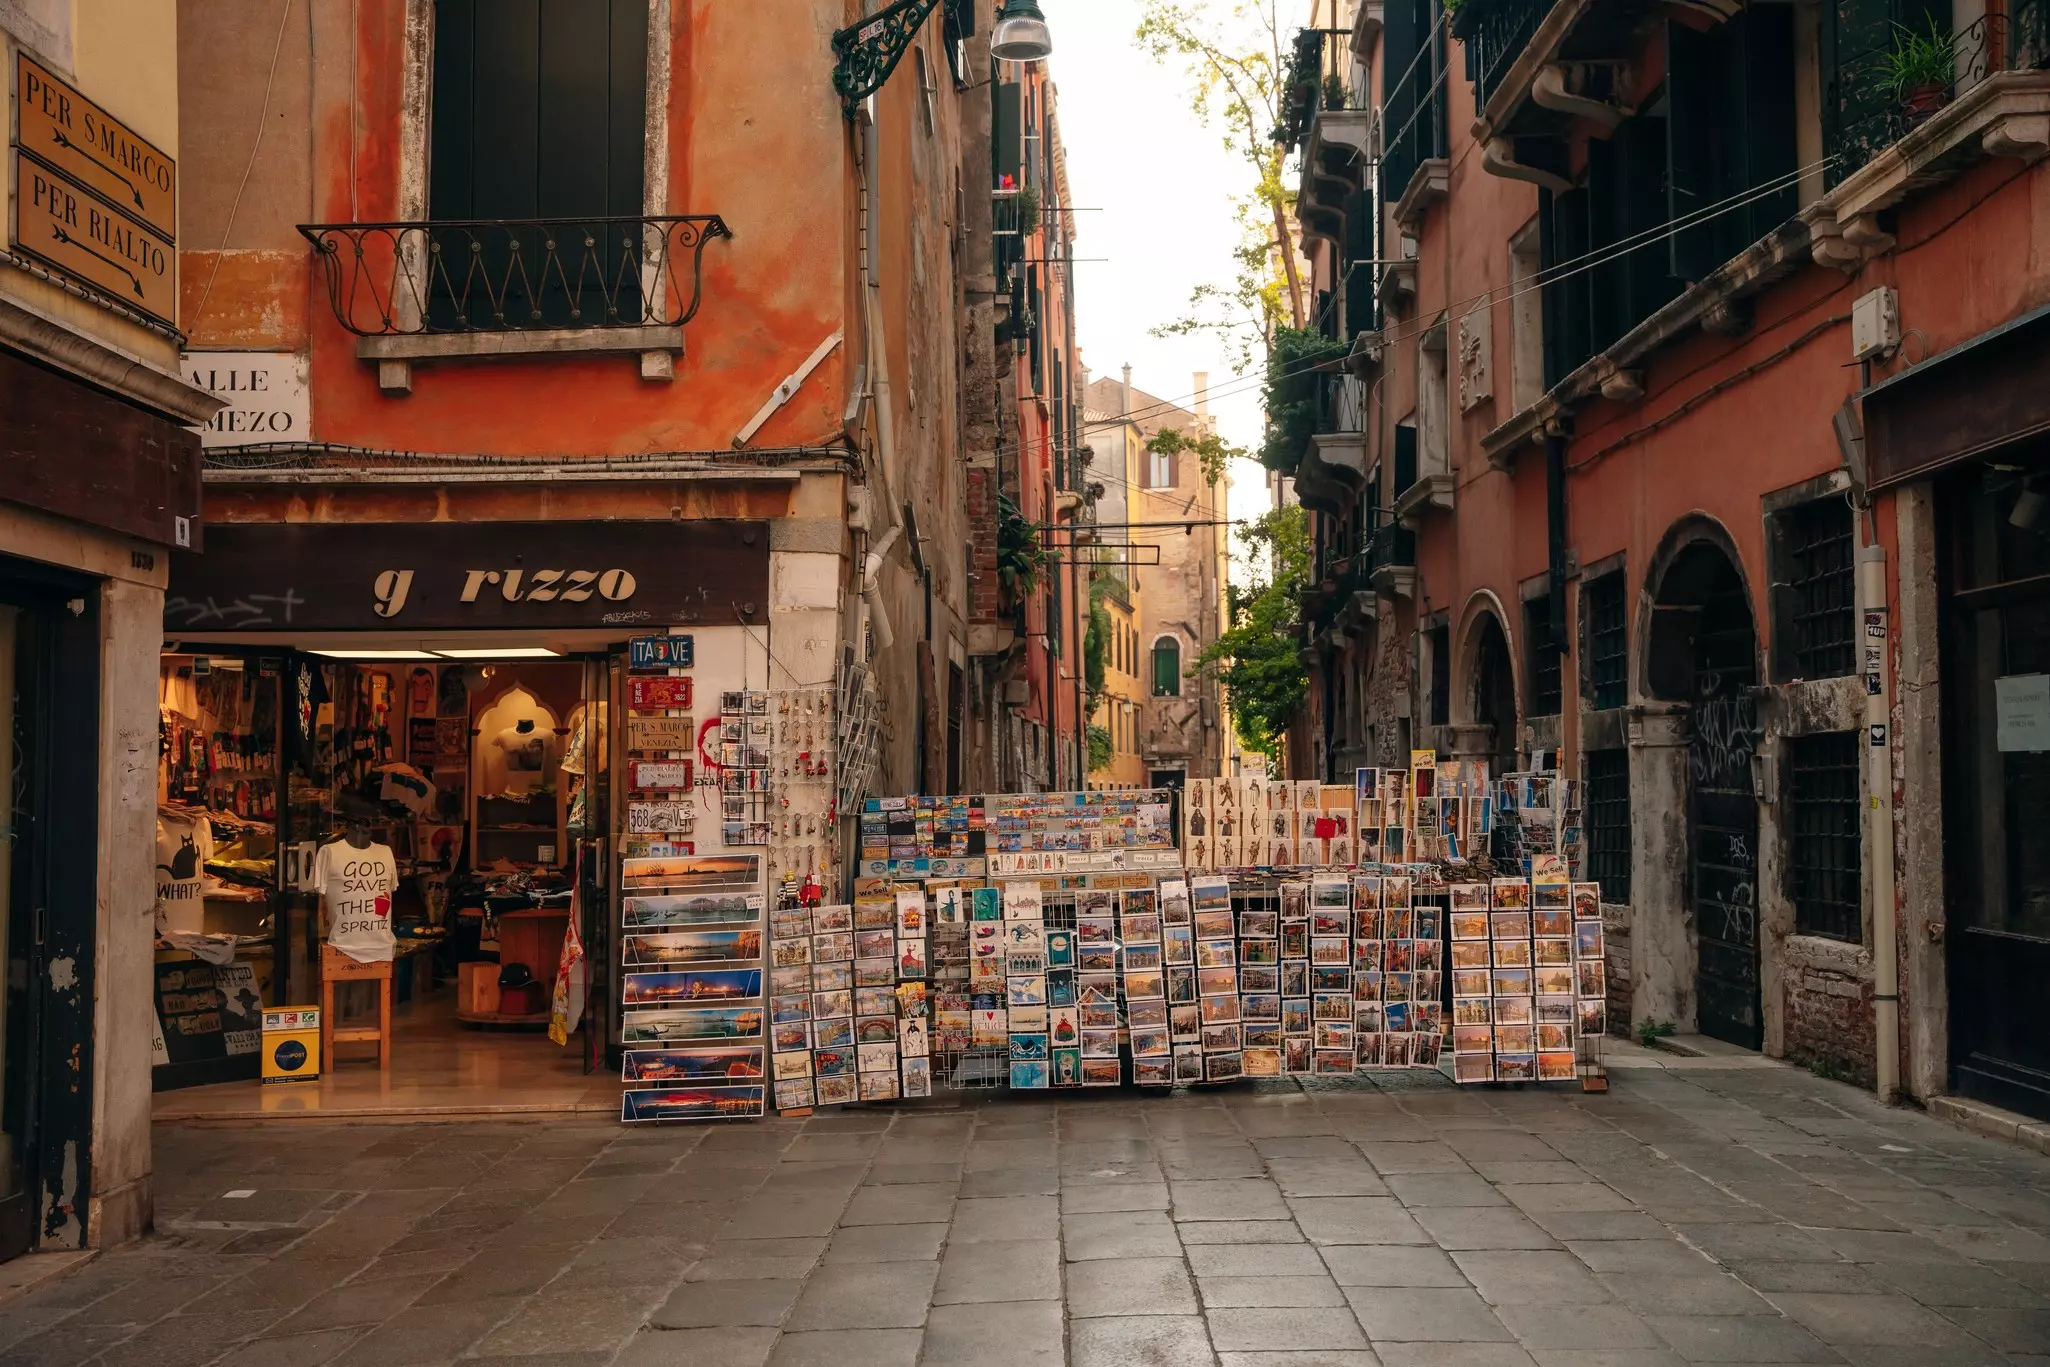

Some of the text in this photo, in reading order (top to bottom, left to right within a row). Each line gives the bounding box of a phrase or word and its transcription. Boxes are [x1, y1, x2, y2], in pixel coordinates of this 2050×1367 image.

[25, 71, 171, 193] PER S.MARCO
[33, 174, 166, 277] PER RIALTO
[181, 370, 269, 391] ALLE
[202, 411, 293, 432] MEZO
[373, 568, 637, 618] g rizzo
[633, 641, 689, 662] ITA VE
[632, 722, 646, 732] PER
[660, 722, 690, 732] MARCO
[630, 808, 649, 827] 568
[343, 861, 386, 879] GOD
[1535, 865, 1564, 877] We Sell
[156, 882, 202, 900] WHAT?
[342, 878, 388, 893] SAVE
[859, 886, 888, 898] We Sell
[337, 899, 374, 916] THE
[340, 919, 388, 934] SPRITZ
